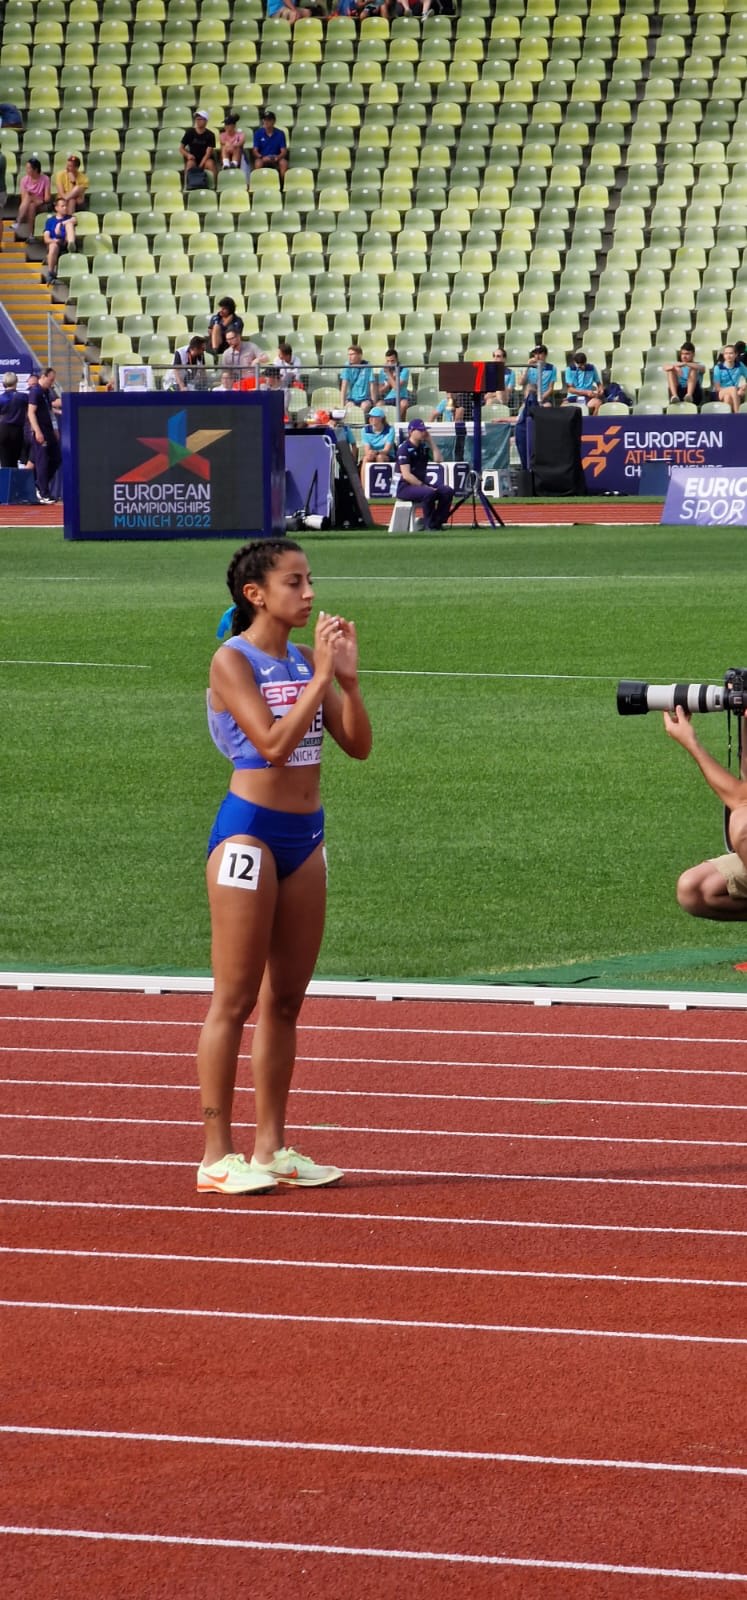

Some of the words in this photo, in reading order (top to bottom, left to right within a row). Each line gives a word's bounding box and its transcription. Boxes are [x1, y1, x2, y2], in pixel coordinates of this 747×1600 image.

[472, 361, 485, 392] 7
[624, 431, 723, 449] EUROPEAN
[624, 449, 705, 464] ATHLETICS
[374, 472, 387, 490] 4
[114, 483, 211, 501] EUROPEAN
[114, 501, 211, 514] CHAMPIONSHIPS
[114, 514, 171, 528] MUNICH
[176, 514, 211, 528] 2022
[229, 853, 254, 881] 12
